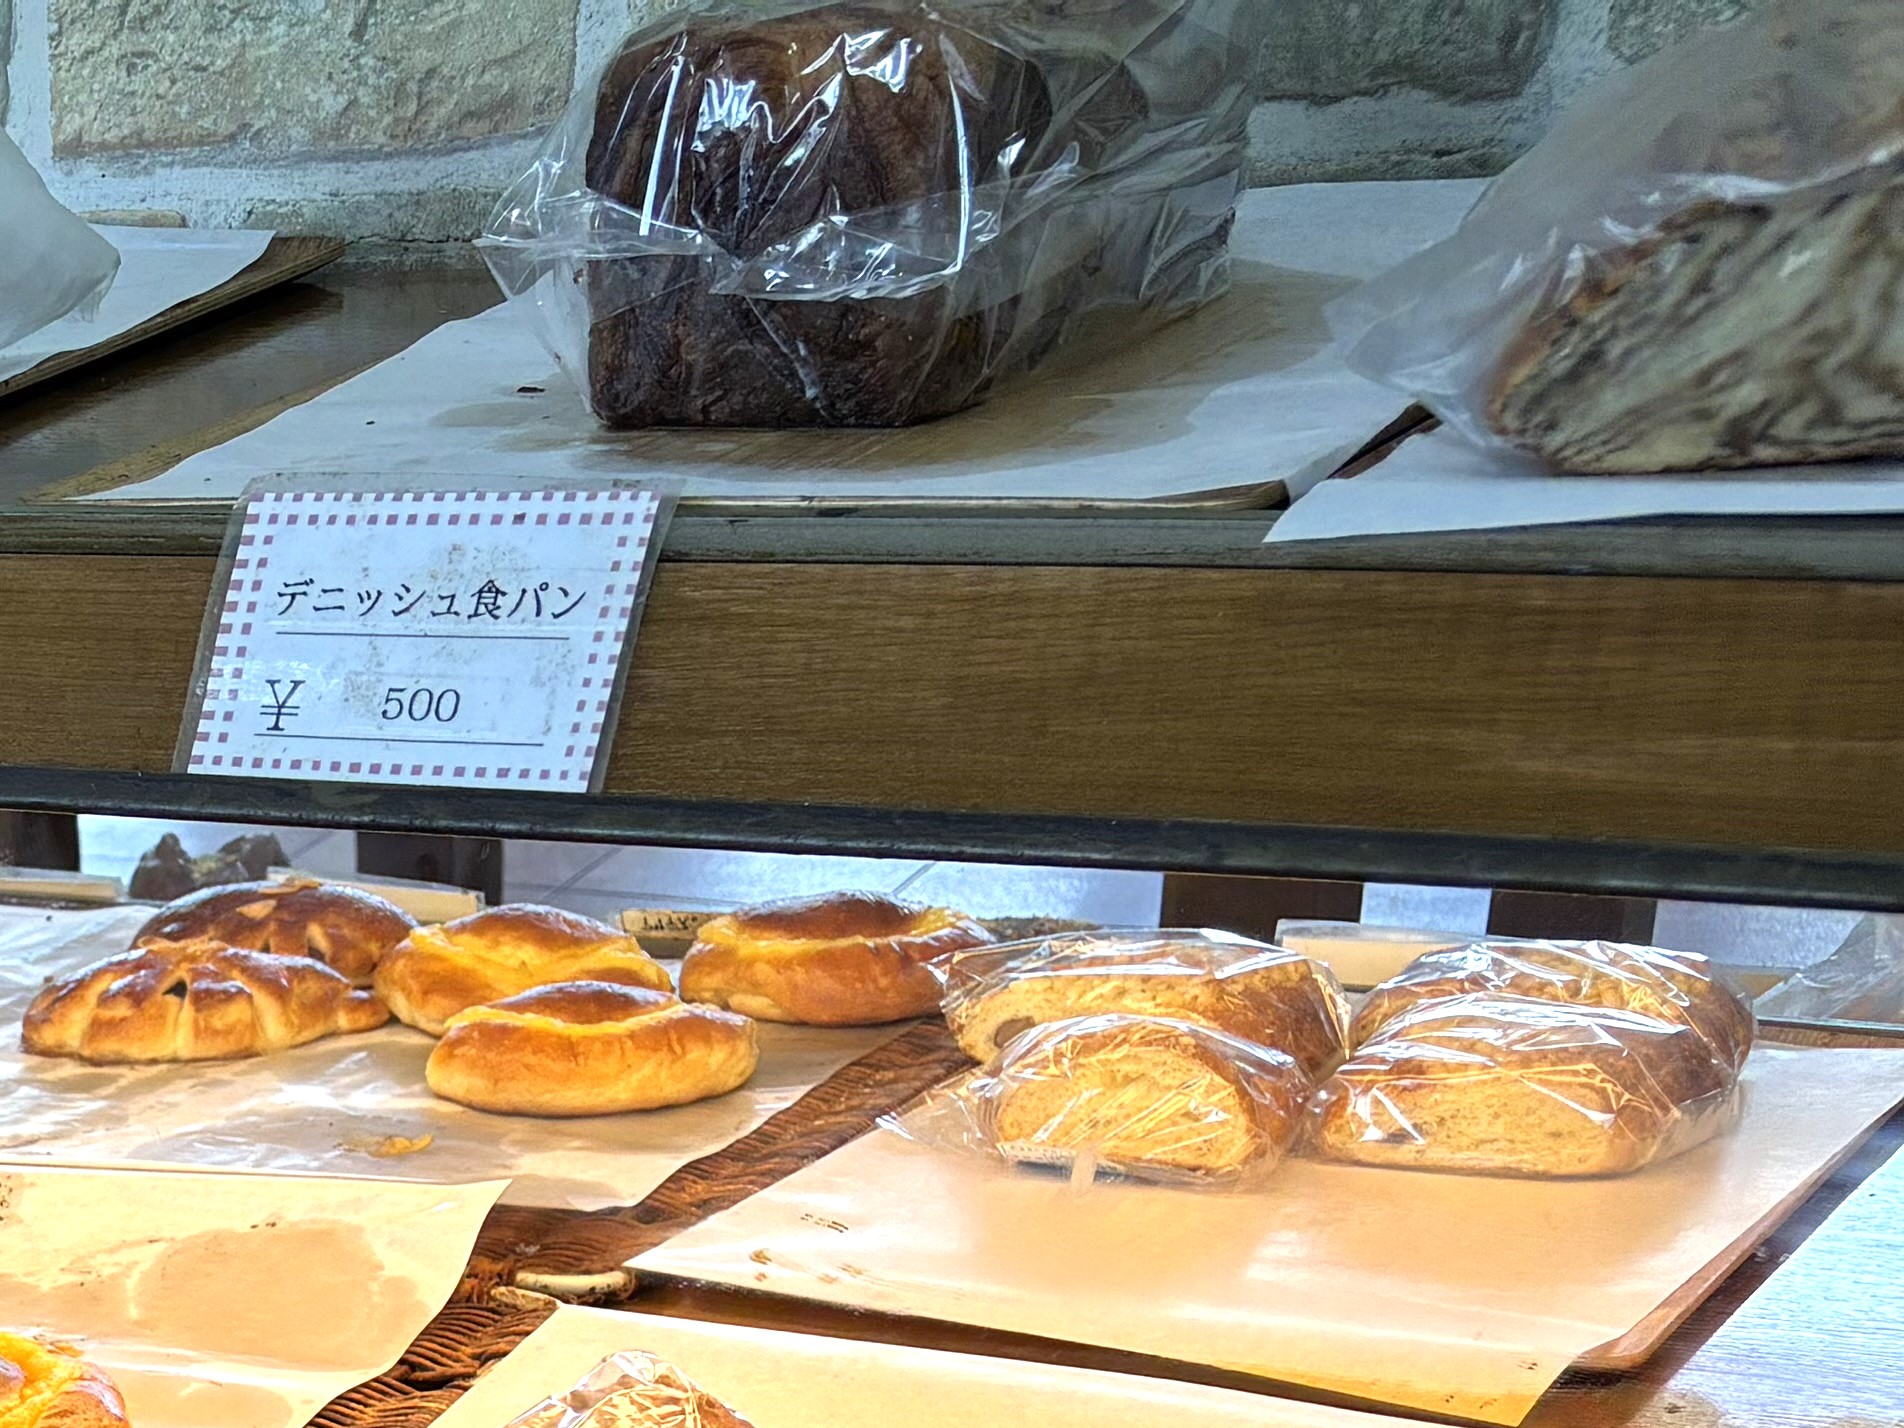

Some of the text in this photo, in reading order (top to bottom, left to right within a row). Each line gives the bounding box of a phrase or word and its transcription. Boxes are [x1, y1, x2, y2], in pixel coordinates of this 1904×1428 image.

[277, 576, 587, 620] デニッシュ食パン
[381, 687, 461, 722] 500
